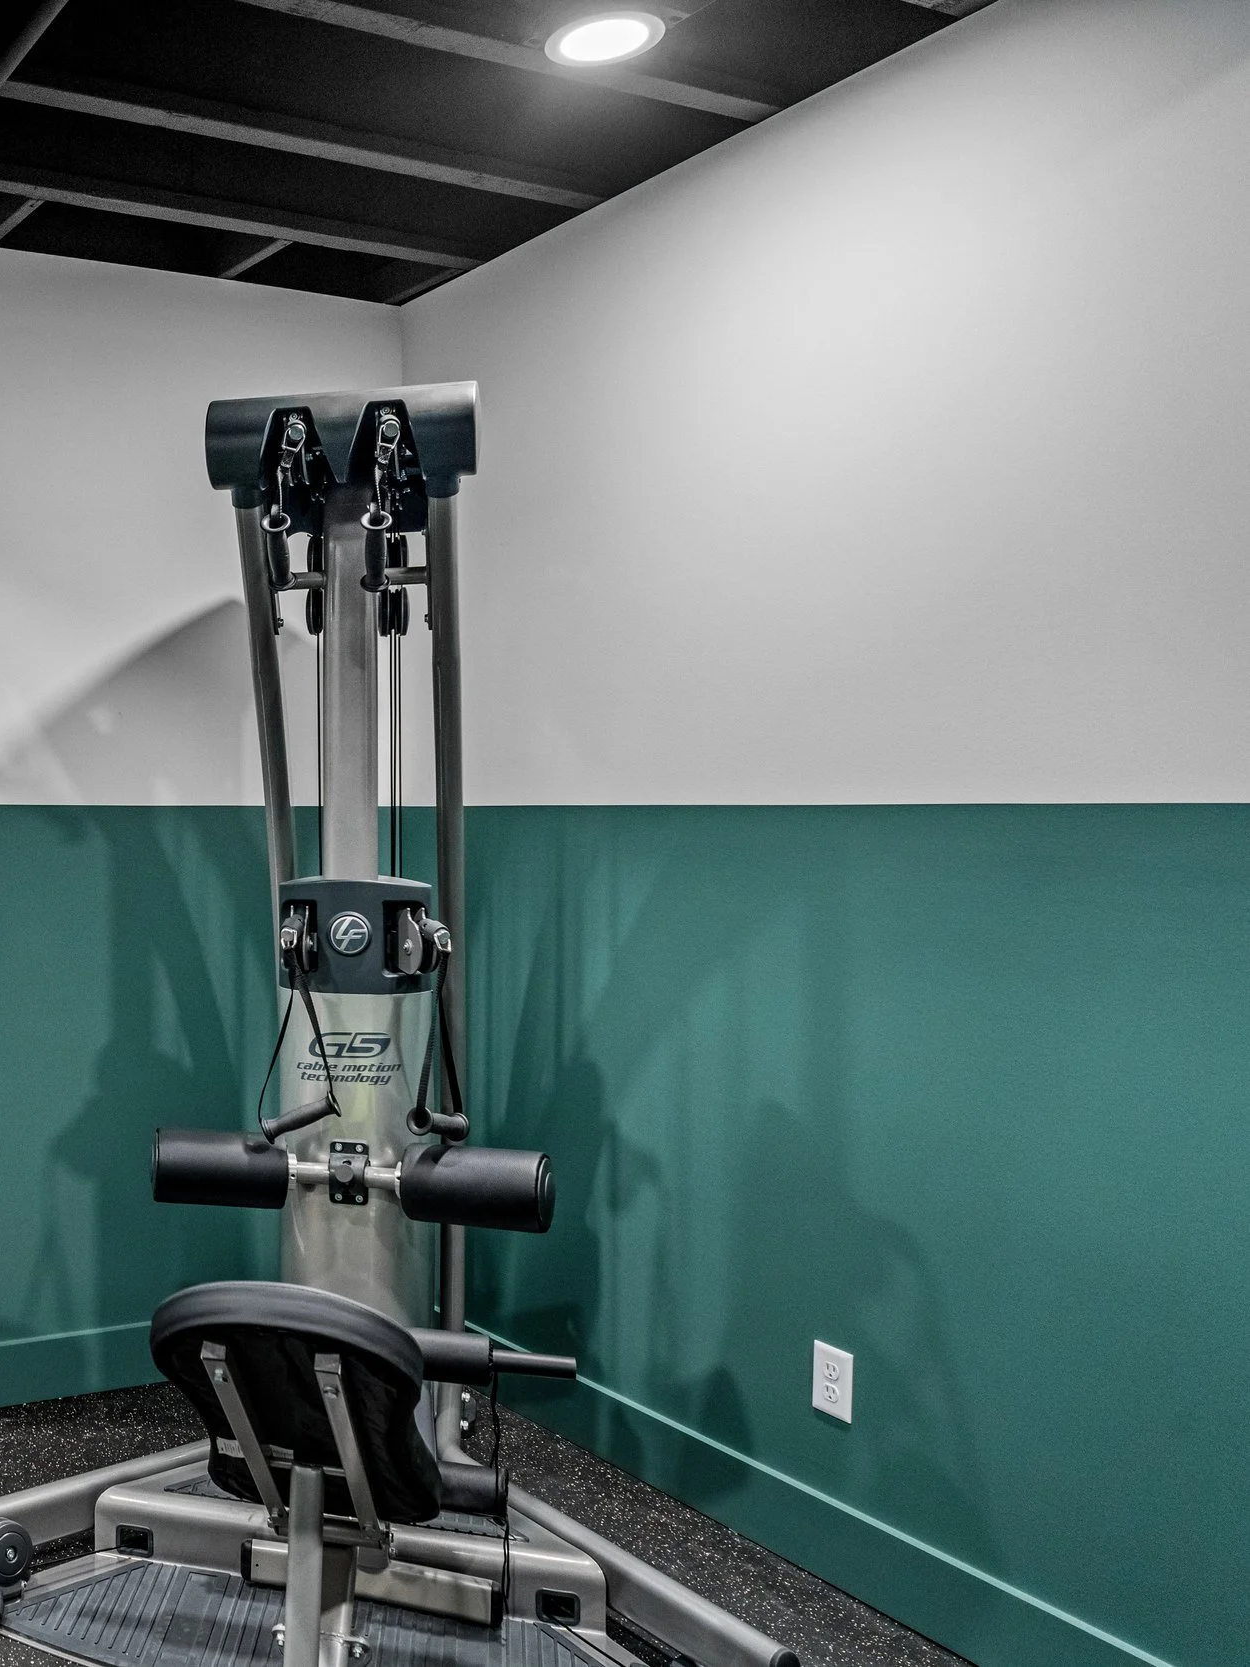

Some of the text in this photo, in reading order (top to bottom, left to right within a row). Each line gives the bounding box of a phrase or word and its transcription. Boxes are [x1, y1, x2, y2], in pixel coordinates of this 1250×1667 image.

[308, 1032, 391, 1058] G5
[342, 1063, 402, 1072] motion
[301, 1072, 391, 1085] technology
